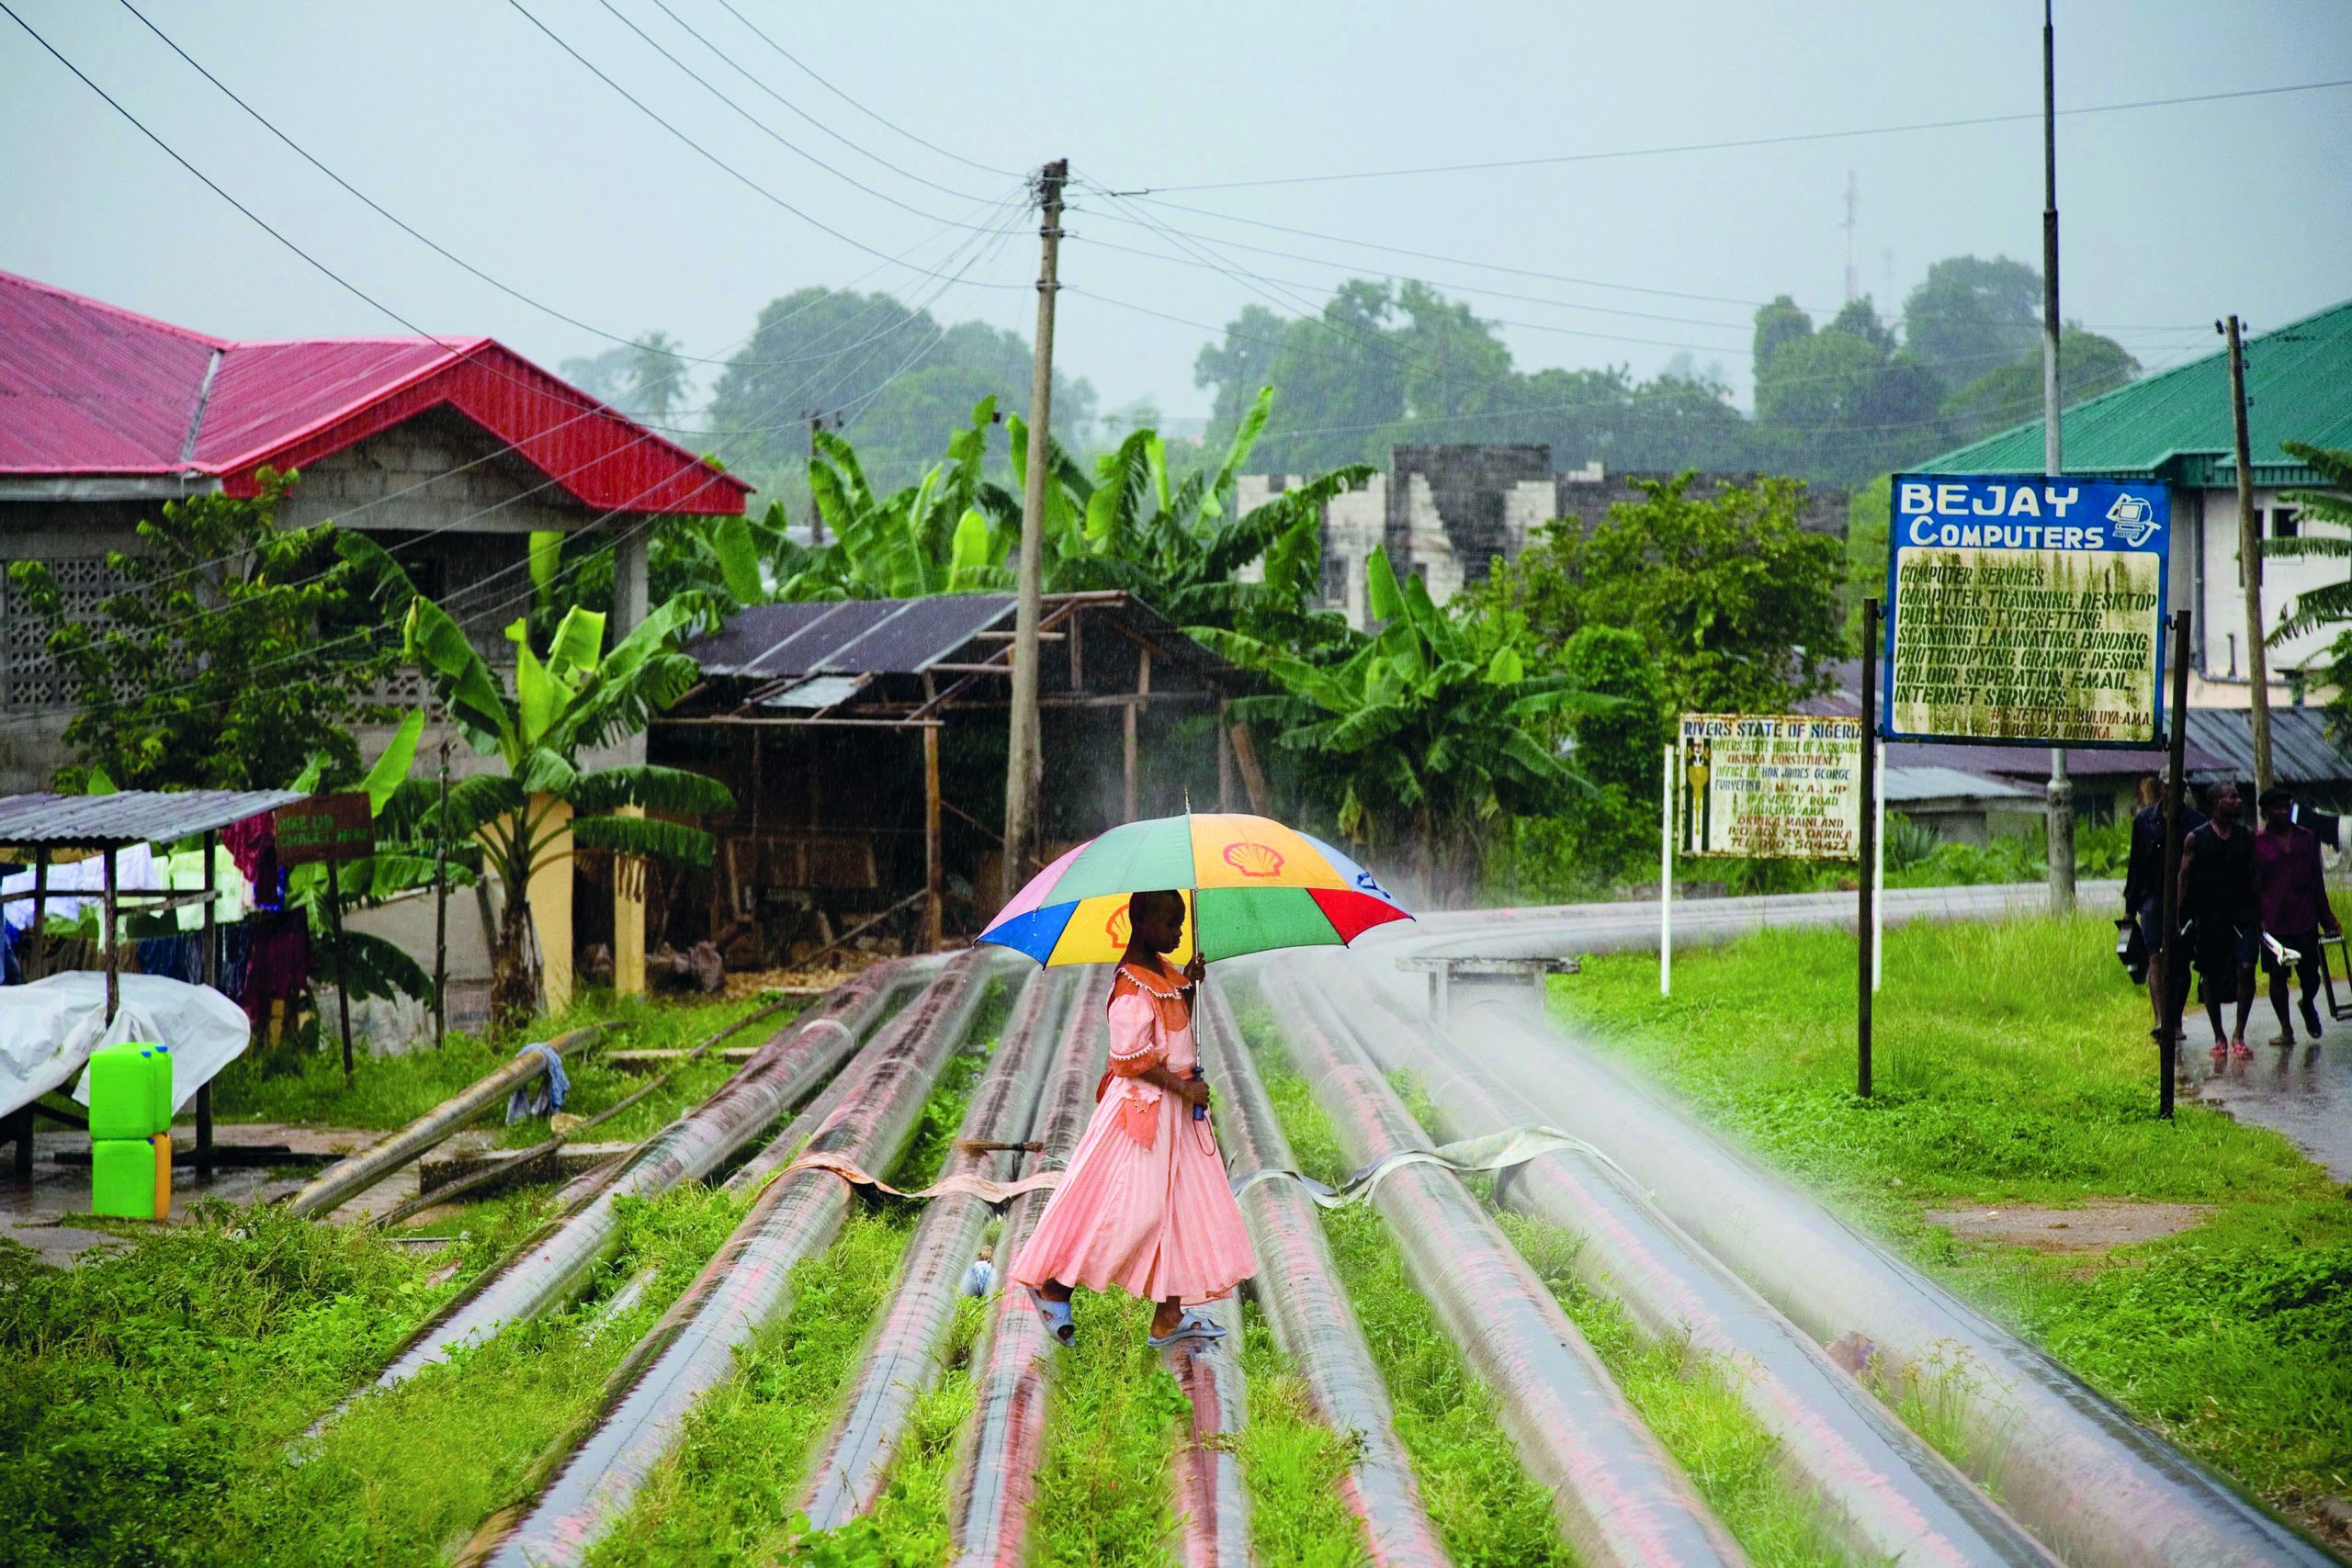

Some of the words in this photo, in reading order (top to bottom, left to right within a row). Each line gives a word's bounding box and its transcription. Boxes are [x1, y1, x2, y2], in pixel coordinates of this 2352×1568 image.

[1901, 483, 2078, 517] BEJAY
[1909, 515, 2104, 548] COMPUTERS
[1900, 566, 1973, 584] COMPUTER
[1980, 567, 2044, 586] SERVICES
[1899, 588, 1983, 606] COMPUTER
[2080, 592, 2157, 612] DESKTOP
[2020, 649, 2086, 669] GRAPHIC
[1896, 666, 1958, 684] COLOUR
[1894, 685, 1980, 705] INTERNET
[2013, 708, 2051, 723] JETTY
[1685, 722, 1732, 737] RIVERS
[1737, 722, 1781, 738] STATE
[1788, 724, 1805, 738] OF
[2011, 722, 2035, 737] BOX
[1712, 739, 1743, 751] RIVERS
[1745, 739, 1770, 752] STATE
[1773, 740, 1799, 753] HOUSE
[1804, 741, 1815, 752] OF
[1728, 754, 1765, 764] OKRIKA
[1771, 755, 1841, 766] CONSTITUENCY
[1716, 766, 1744, 777] OFFICE
[1747, 766, 1758, 778] OF
[1781, 768, 1809, 779] JAMES
[1815, 769, 1850, 780] GEORGE
[1768, 794, 1805, 805] JETTY
[1810, 795, 1838, 806] ROAD
[1737, 816, 1780, 826] OKRIKA
[1785, 817, 1843, 828] MAINLAND
[1756, 827, 1778, 837] BOX
[1806, 829, 1851, 840] OKRIKA
